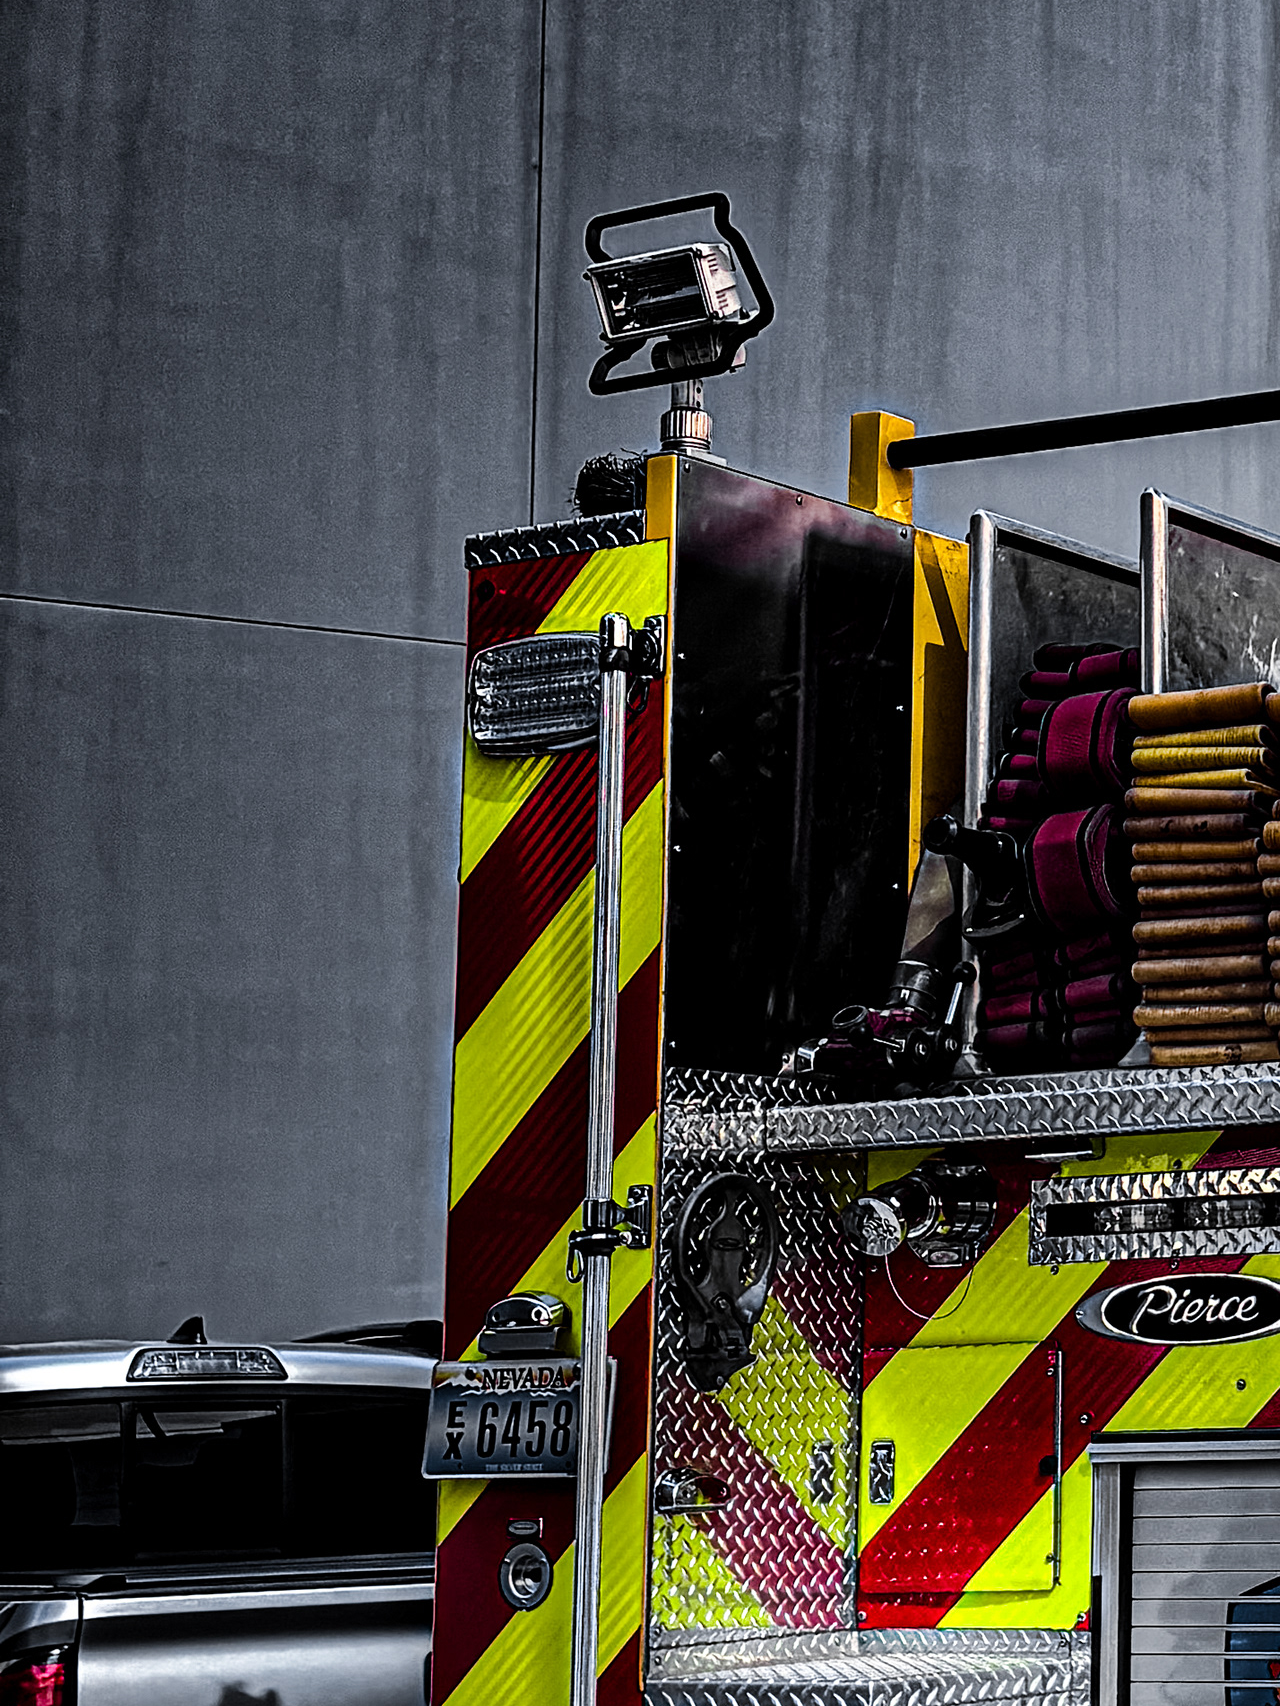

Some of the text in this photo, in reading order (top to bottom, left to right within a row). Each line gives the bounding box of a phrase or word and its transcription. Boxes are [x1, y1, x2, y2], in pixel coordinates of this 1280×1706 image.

[1132, 1284, 1260, 1335] Pierce
[480, 1365, 569, 1390] NEVADA
[476, 1399, 574, 1459] 6458
